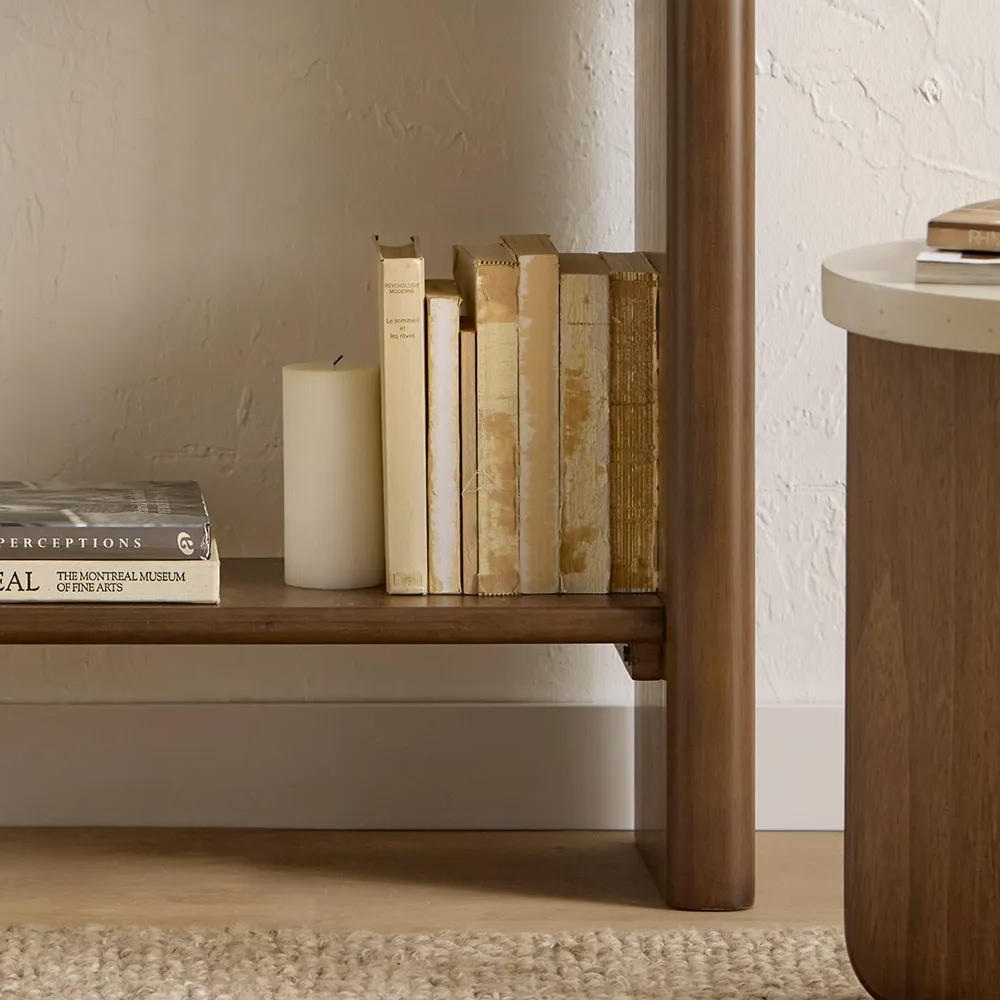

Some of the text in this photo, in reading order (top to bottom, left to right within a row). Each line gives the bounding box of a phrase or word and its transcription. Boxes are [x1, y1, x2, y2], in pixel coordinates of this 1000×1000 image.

[56, 571, 186, 582] THE MONTREAL MUSEUM
[56, 582, 123, 592] OF FINE ARTS
